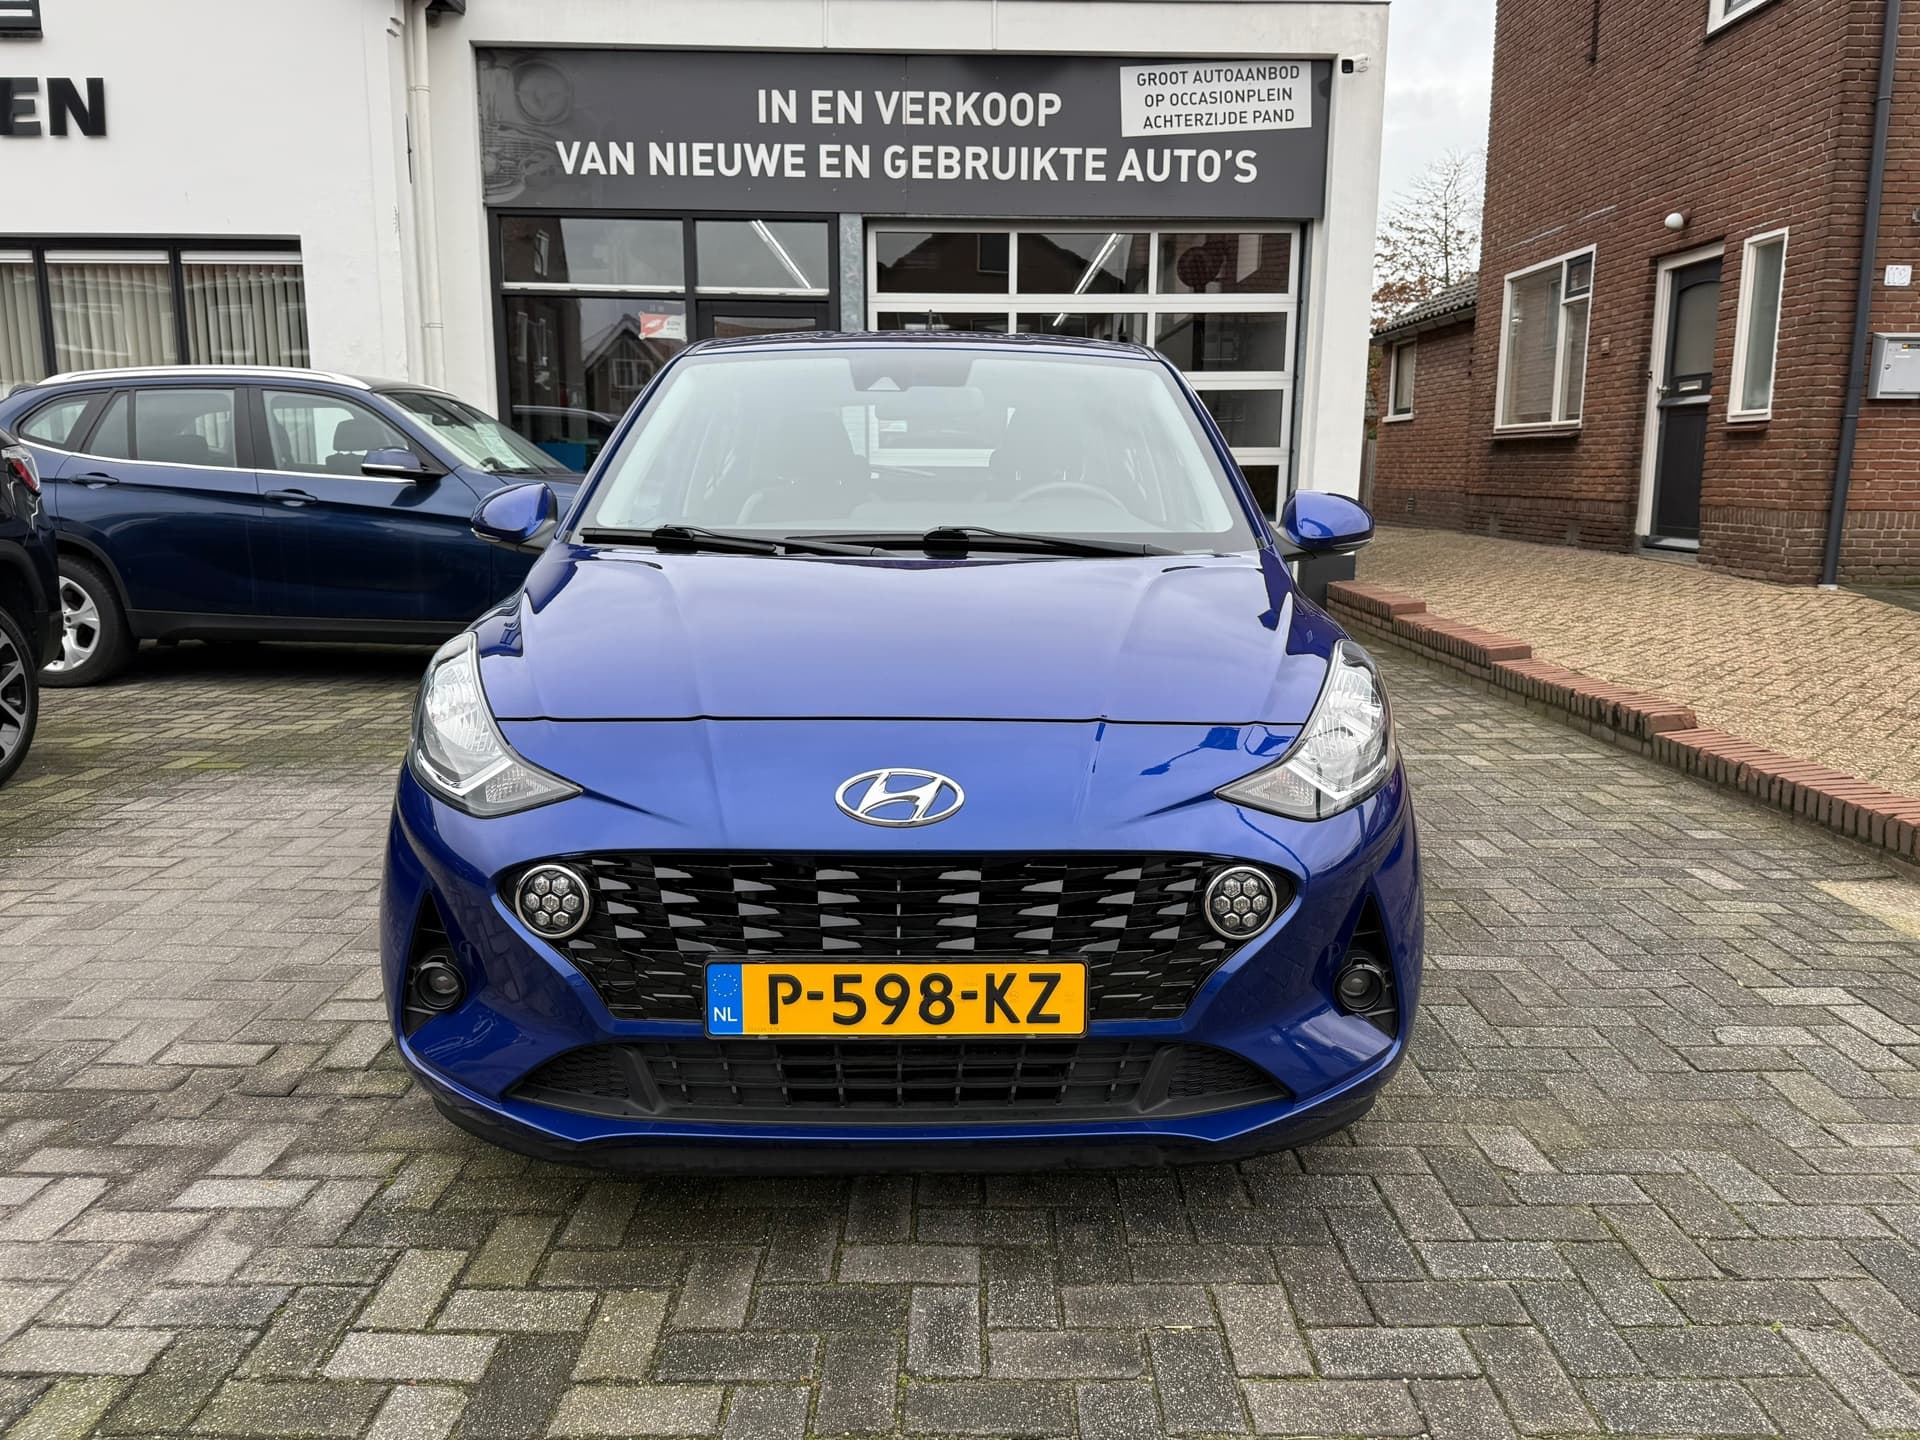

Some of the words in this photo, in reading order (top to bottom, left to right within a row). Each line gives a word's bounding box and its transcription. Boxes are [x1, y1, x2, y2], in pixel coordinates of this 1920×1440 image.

[1136, 72, 1188, 87] GROOT
[1193, 65, 1300, 85] AUTOAANBOD
[758, 89, 797, 124] IN
[811, 90, 863, 125] EN
[874, 91, 1062, 126] VERKOOP
[1144, 93, 1165, 108] OP
[1169, 87, 1293, 107] OCCASIONPLEIN
[1143, 111, 1248, 129] ACHTERZIJDE
[1252, 108, 1295, 124] PAND
[555, 141, 635, 176] VAN
[648, 142, 806, 178] NIEUWE
[819, 144, 870, 179] EN
[884, 145, 1107, 182] GEBRUIKTE
[1117, 148, 1258, 183] AUTO'S
[713, 1006, 738, 1022] NL
[768, 972, 1061, 1026] P-598-KZ
